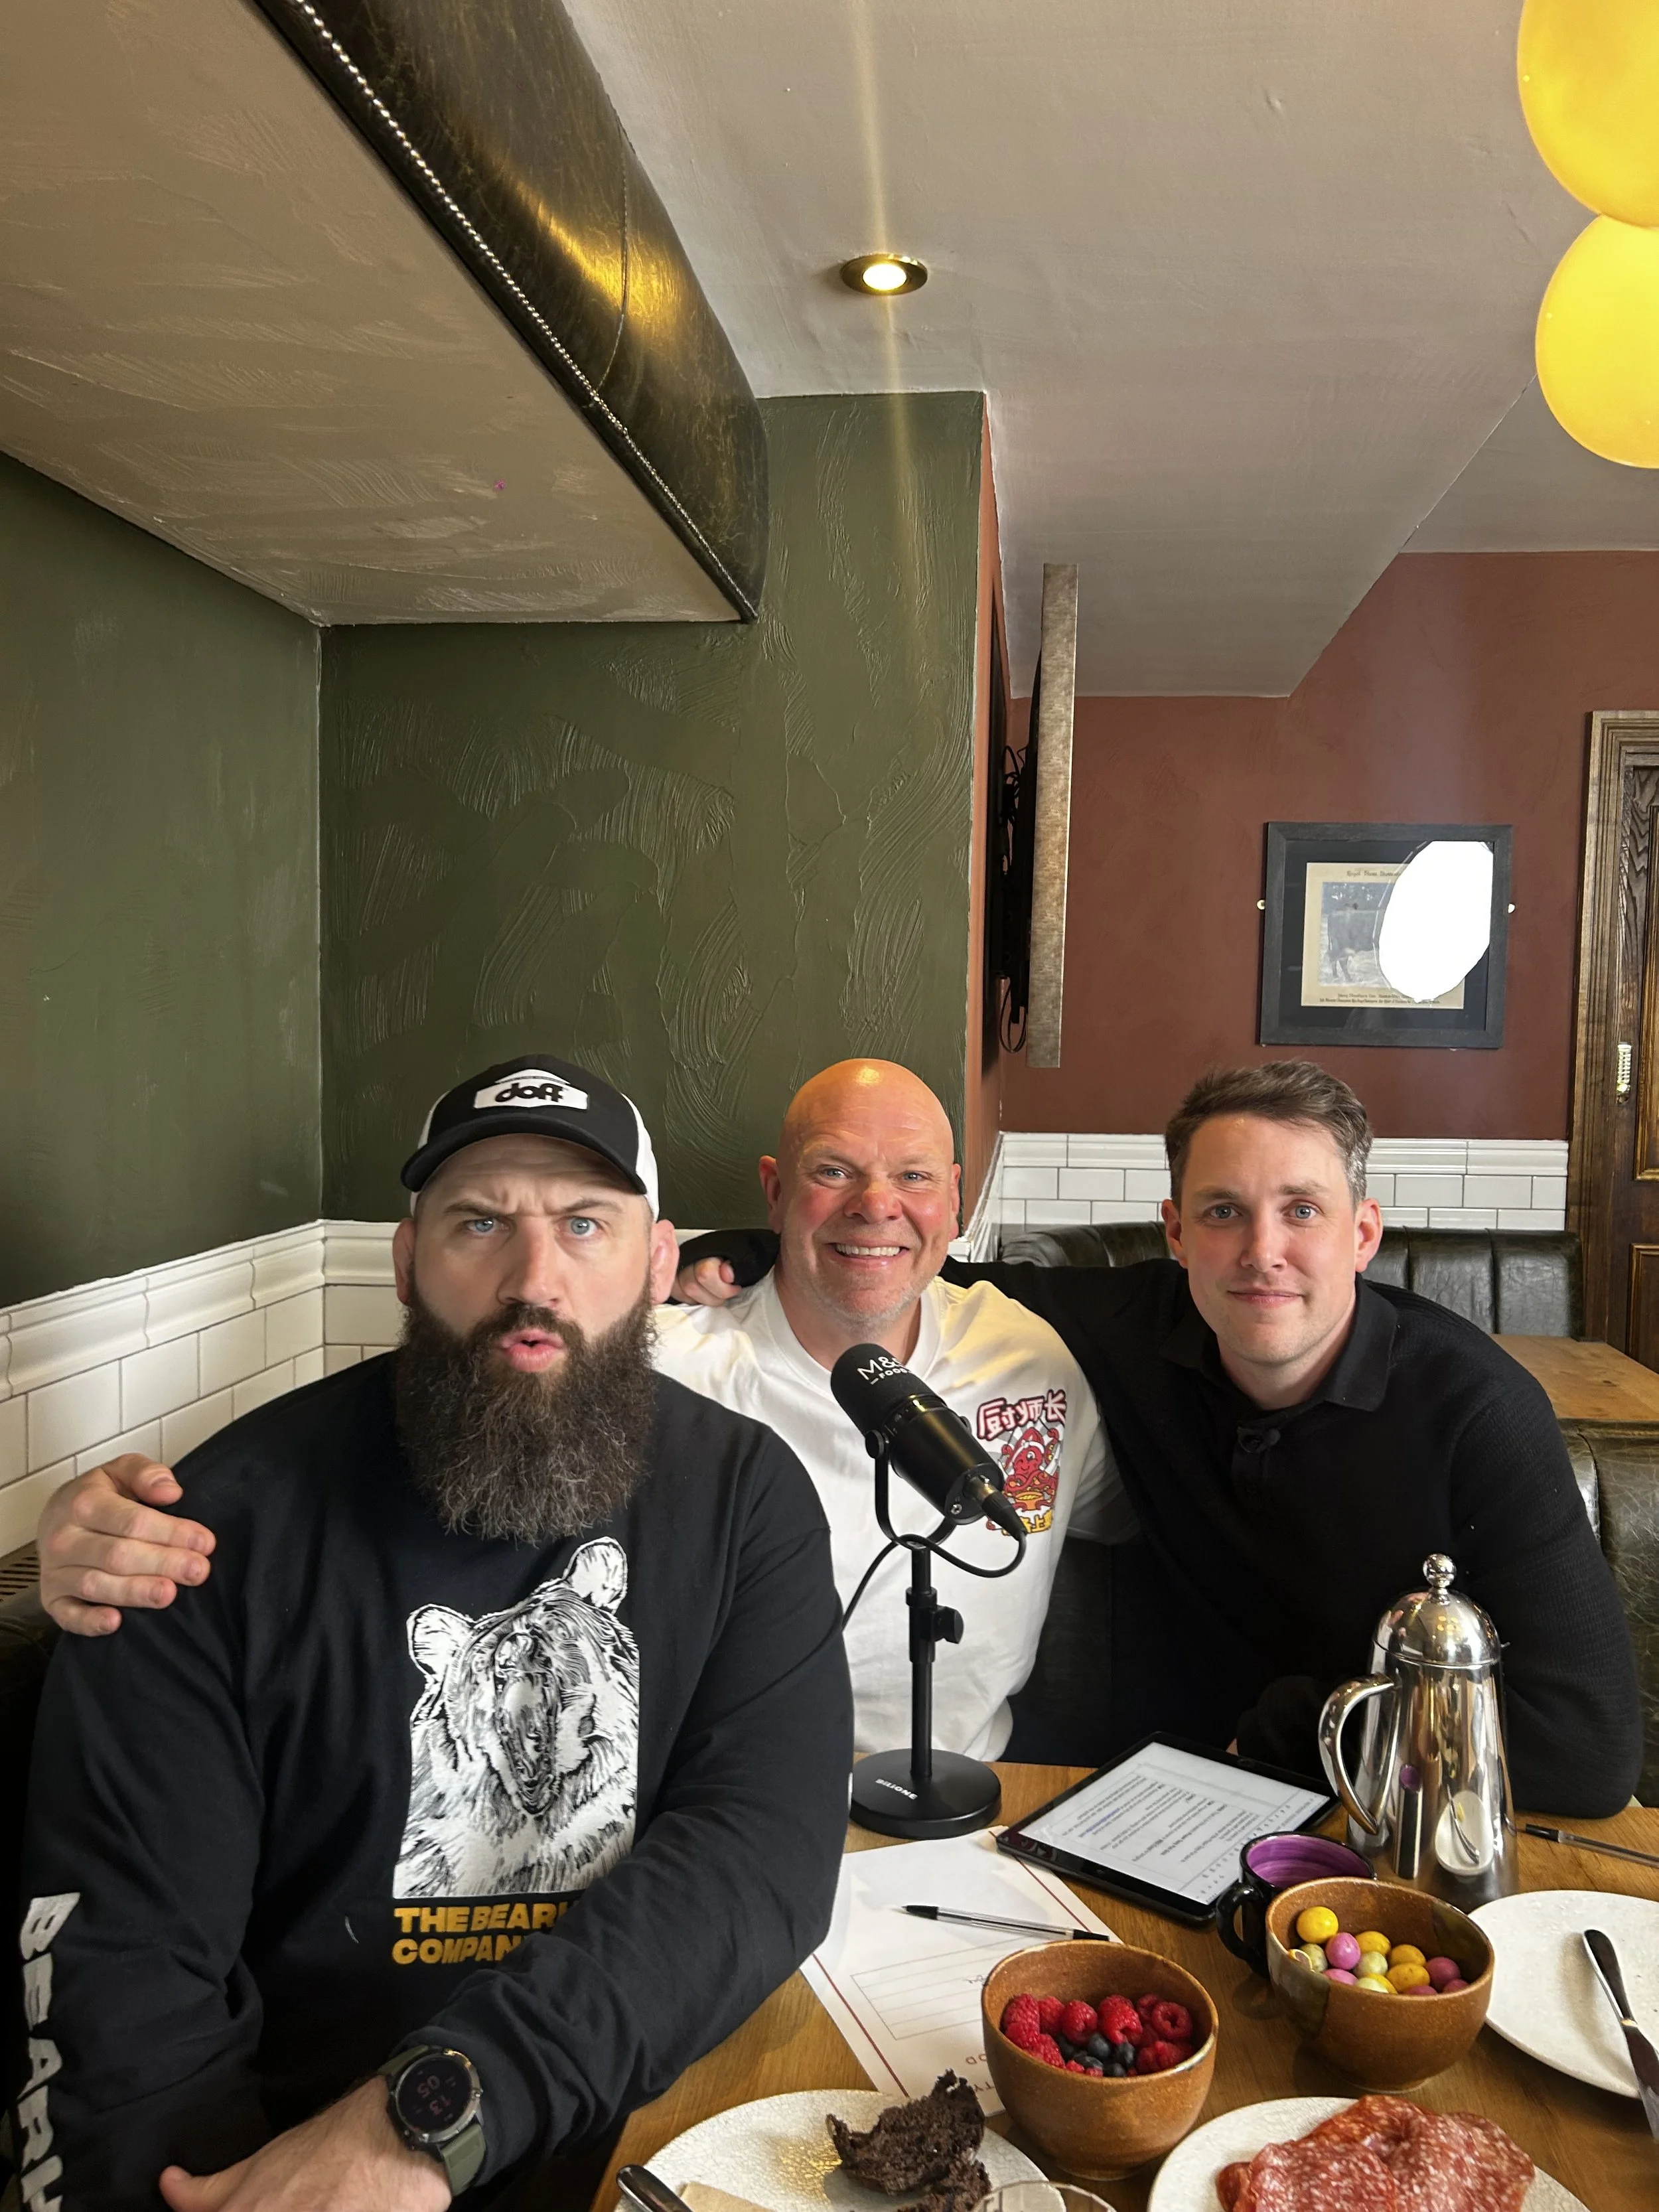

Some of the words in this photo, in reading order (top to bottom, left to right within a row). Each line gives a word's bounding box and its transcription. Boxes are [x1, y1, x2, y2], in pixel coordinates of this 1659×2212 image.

[495, 1082, 564, 1102] doff
[977, 1388, 1067, 1441] 厨师长
[392, 1934, 522, 1964] COMPAN
